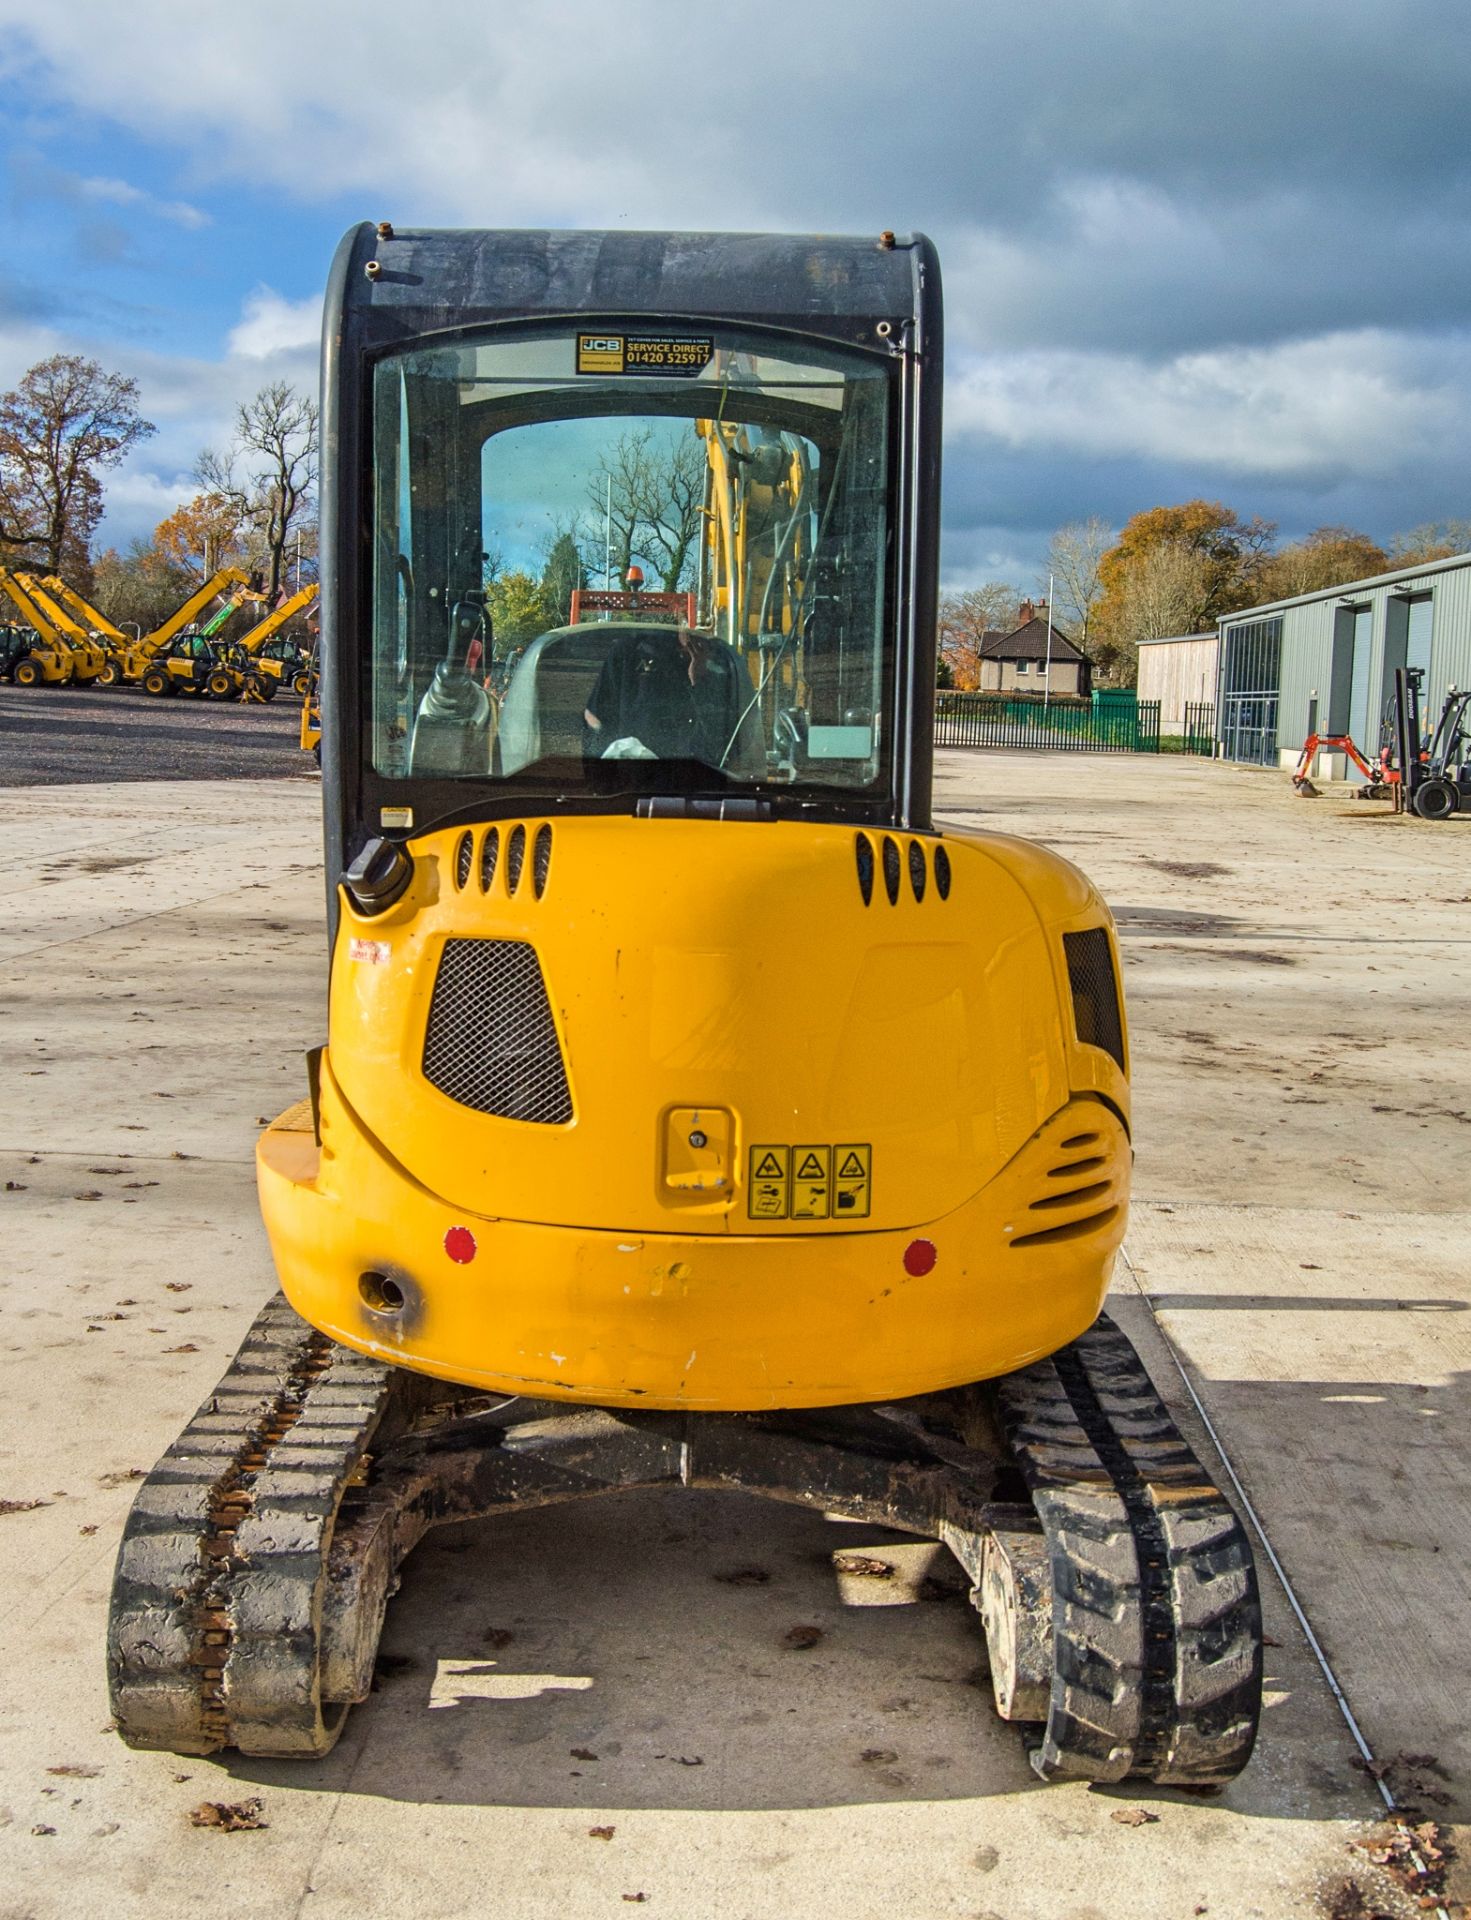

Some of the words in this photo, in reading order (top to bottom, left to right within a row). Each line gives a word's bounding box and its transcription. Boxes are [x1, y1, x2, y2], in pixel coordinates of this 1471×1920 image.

[583, 340, 620, 351] JCB
[627, 344, 670, 352] SERVICE
[673, 344, 710, 353] DIRECT
[627, 353, 664, 363] 01420
[667, 354, 710, 364] 525917
